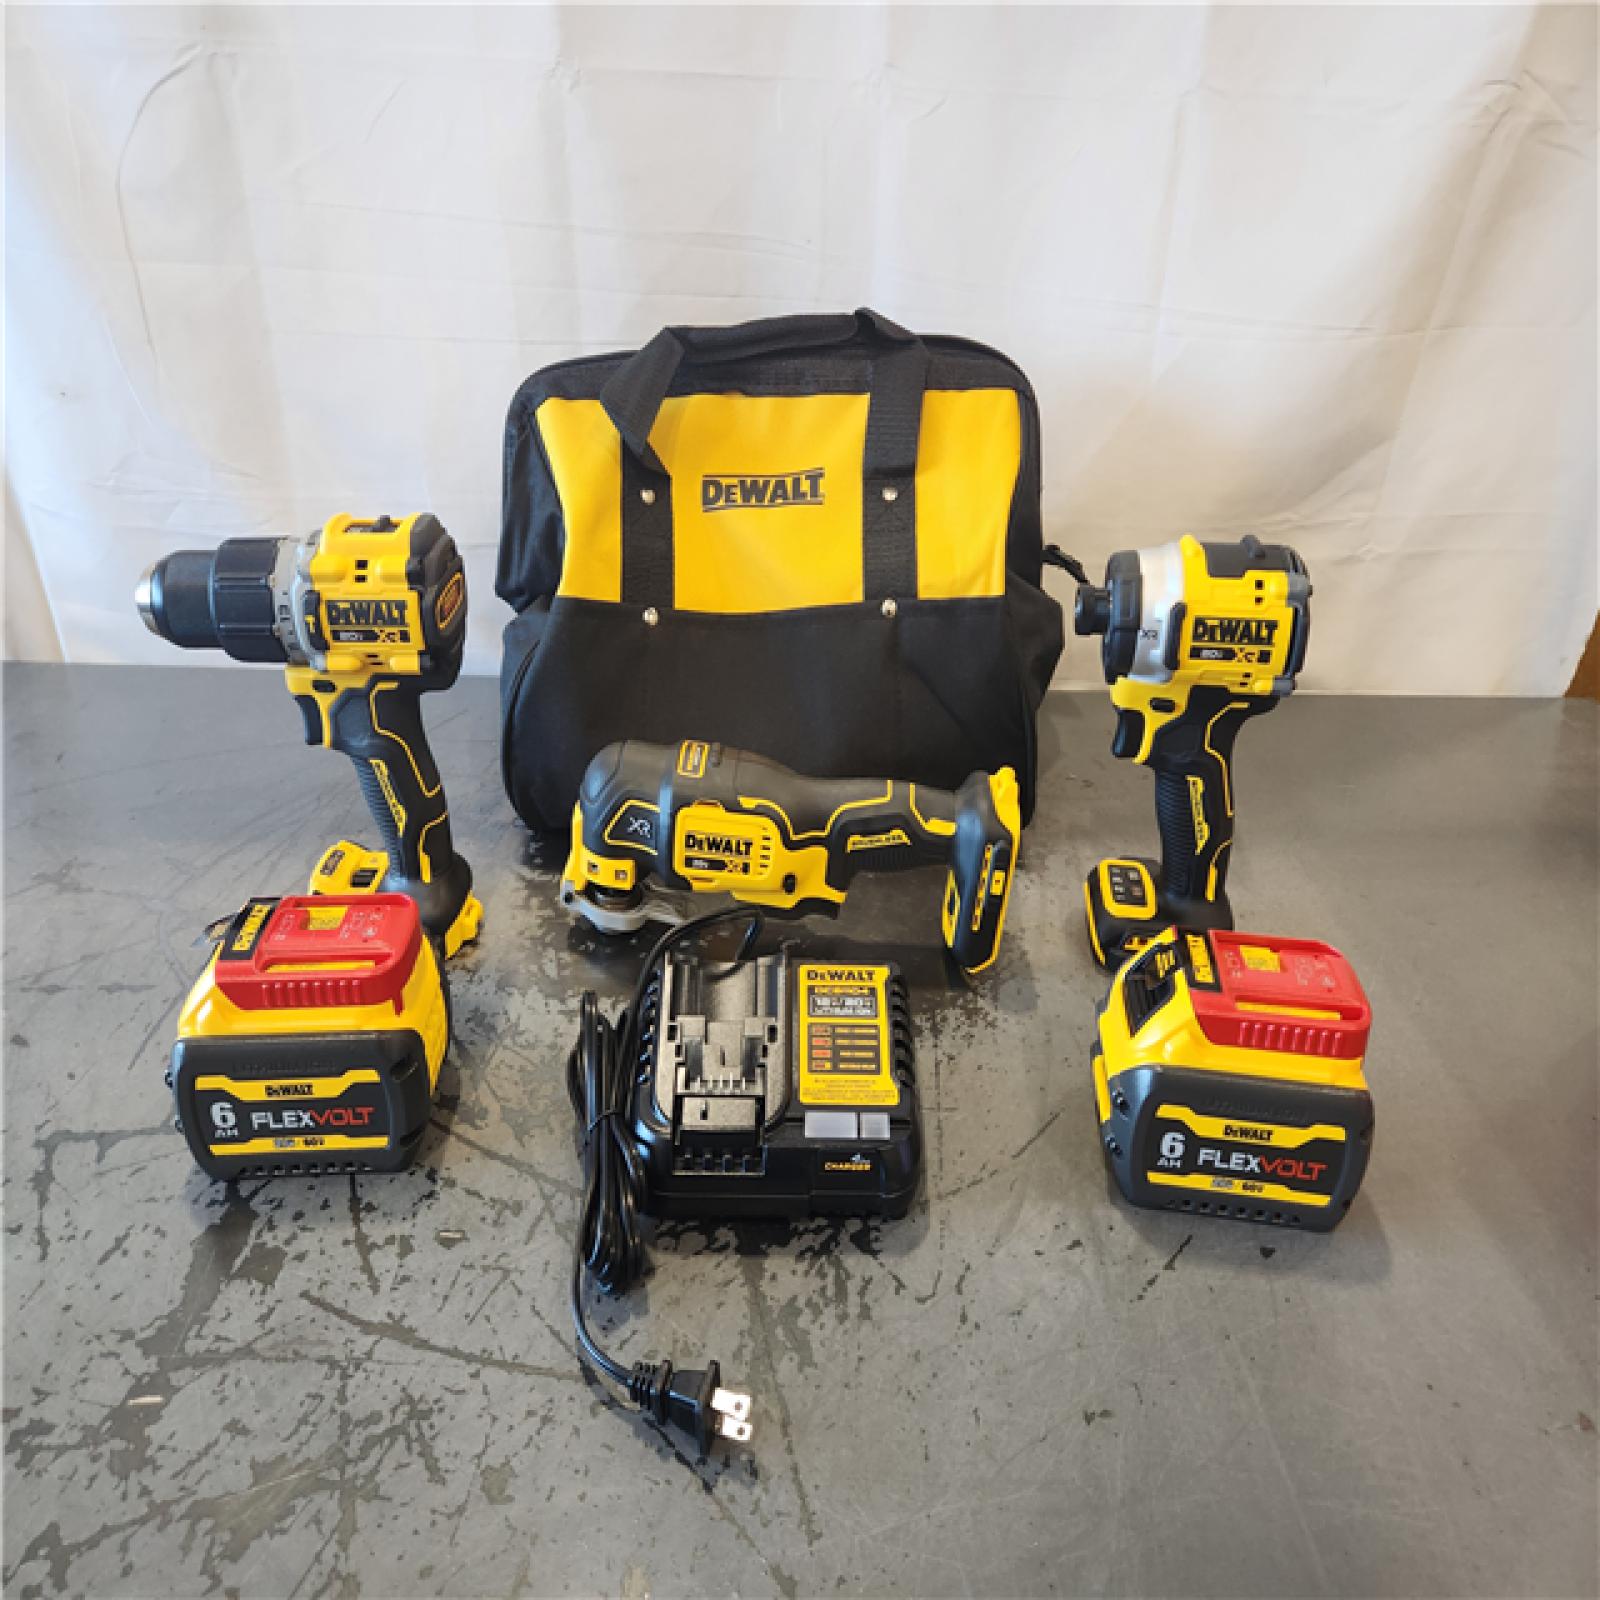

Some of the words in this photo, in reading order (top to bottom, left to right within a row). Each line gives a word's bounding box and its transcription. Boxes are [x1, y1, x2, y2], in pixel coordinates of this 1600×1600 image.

[211, 1102, 236, 1128] 6
[251, 1107, 374, 1130] FLEXVOLT
[1160, 1132, 1186, 1158] 6
[1197, 1147, 1328, 1181] FLEXVOLT
